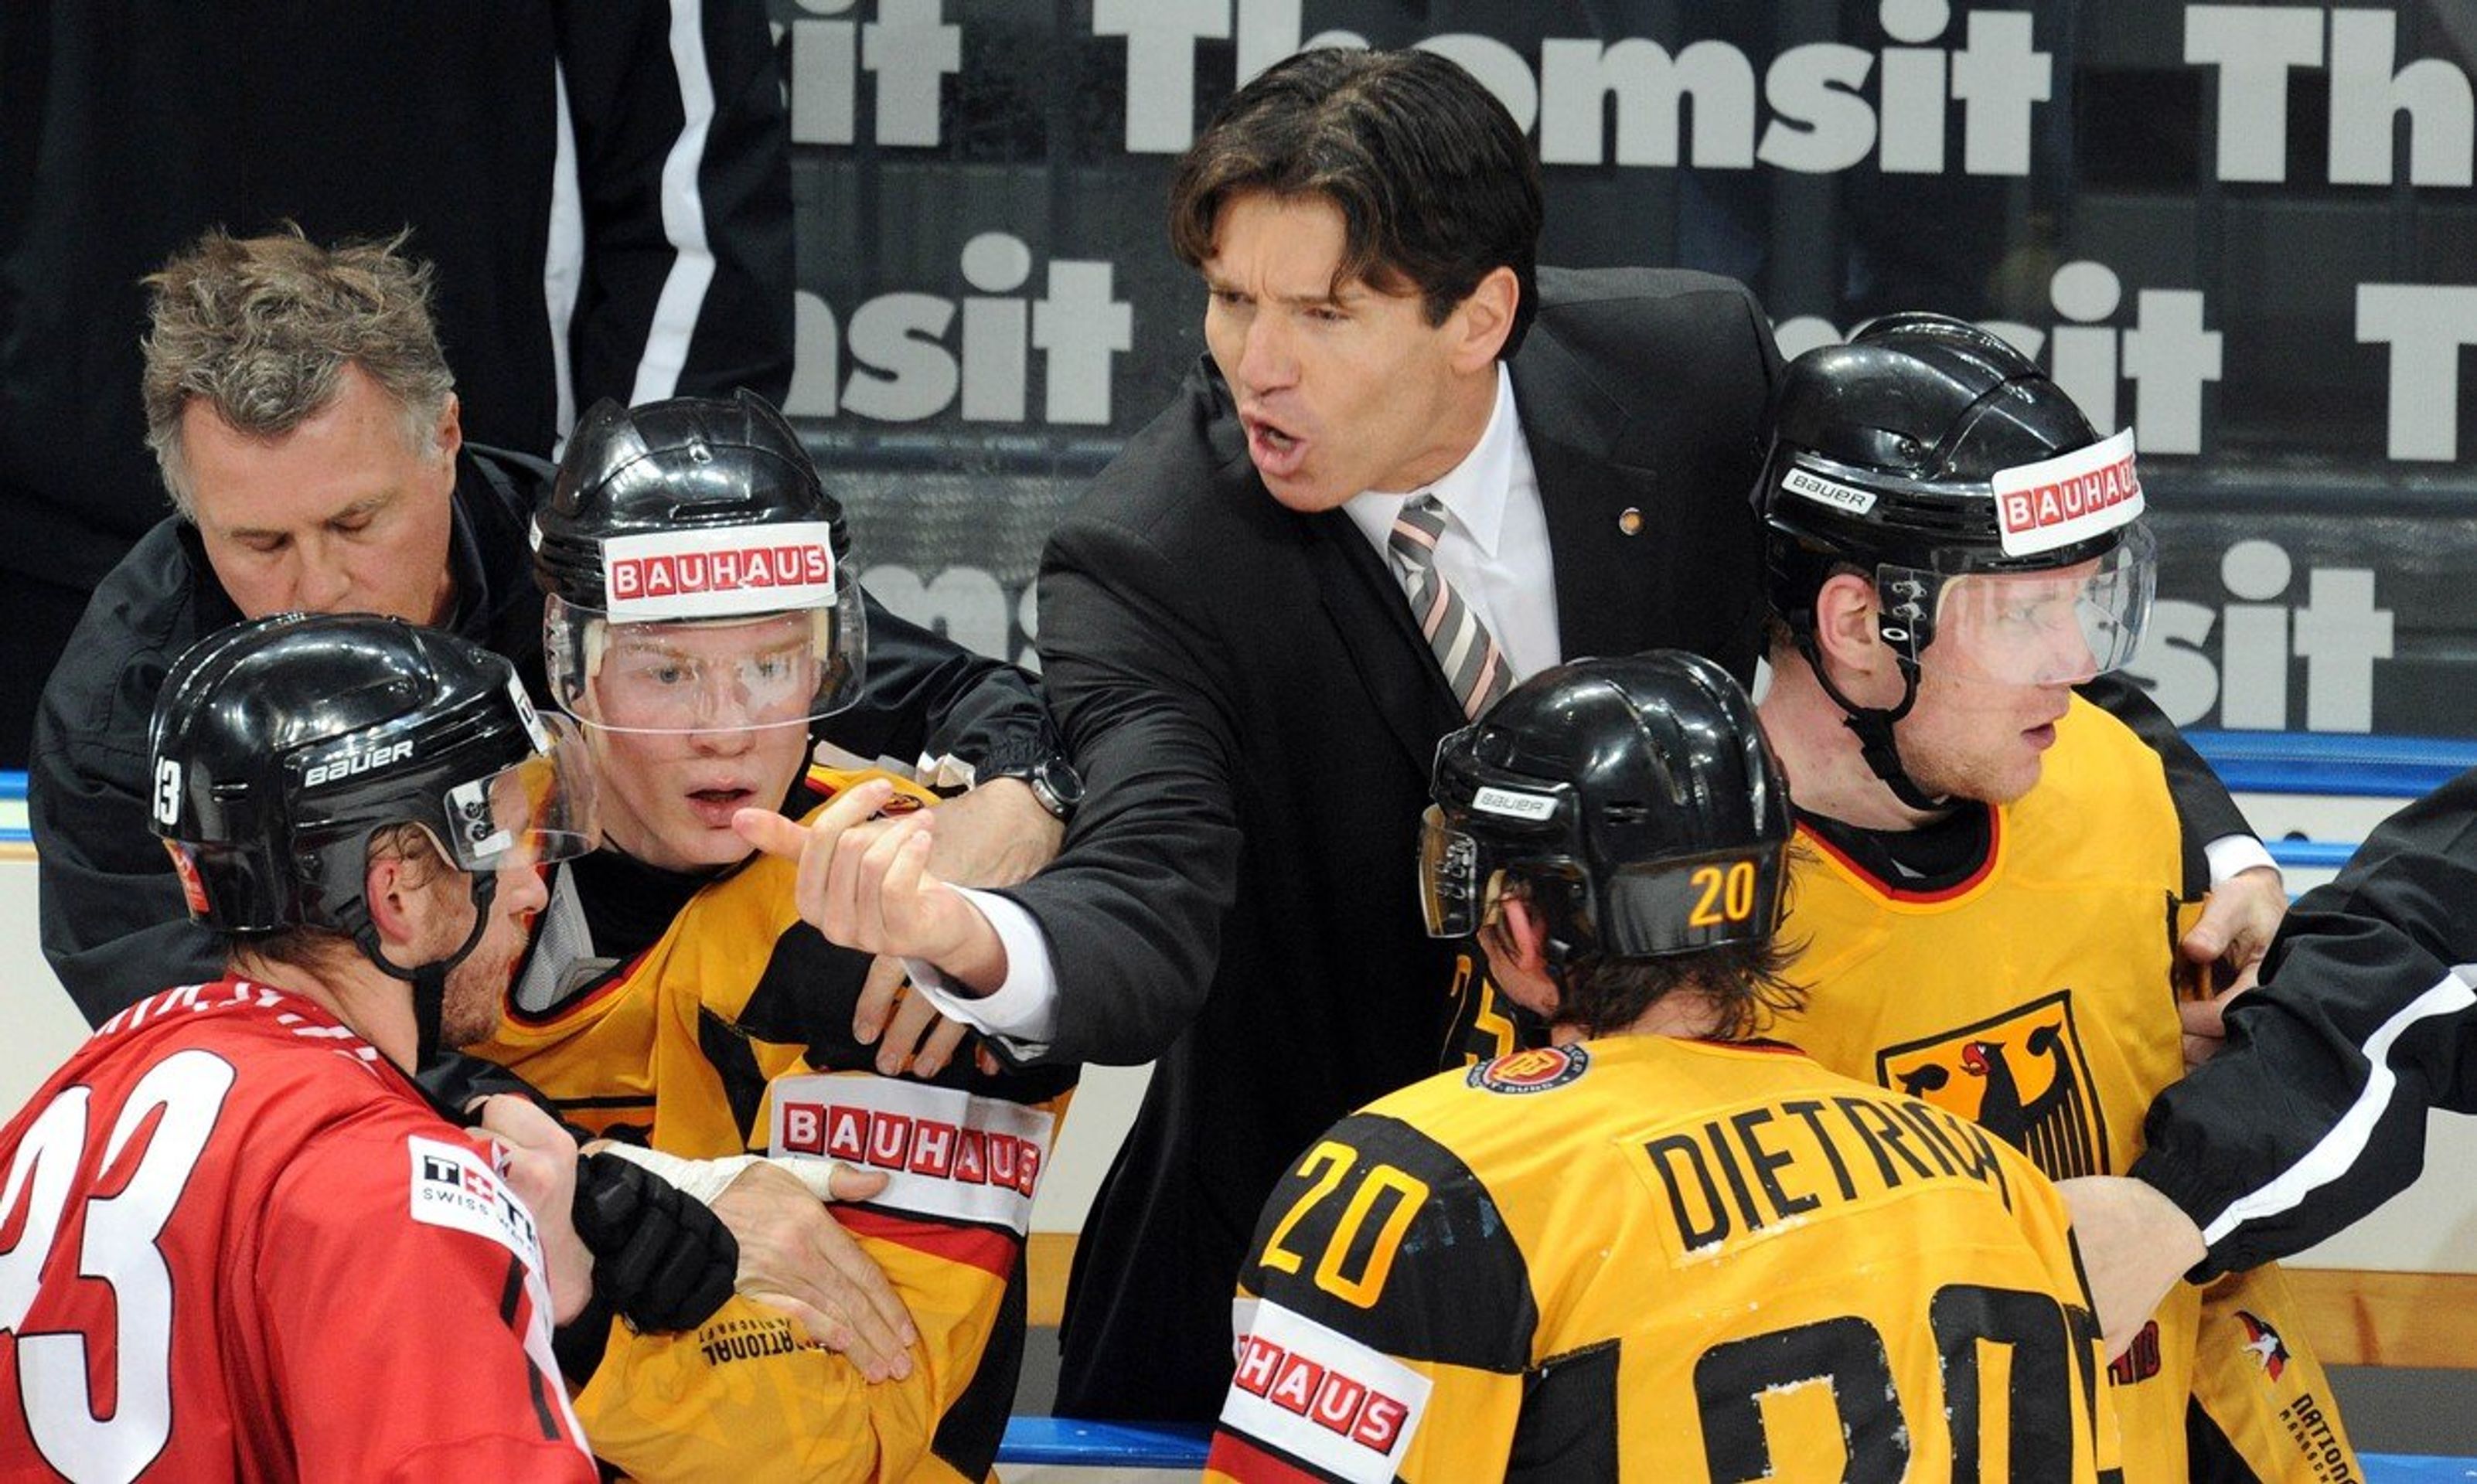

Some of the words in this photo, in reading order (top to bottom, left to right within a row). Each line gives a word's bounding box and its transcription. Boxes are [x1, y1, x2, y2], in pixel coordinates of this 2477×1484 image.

[768, 0, 962, 146] it
[2184, 5, 2475, 187] Th
[1790, 473, 1869, 509] BAUER
[2007, 458, 2138, 529] BAUHAU
[615, 546, 828, 595] BAUHAUS
[304, 740, 414, 788] BAUER
[1687, 861, 1756, 928] 20
[423, 1187, 489, 1216] SWISS
[1259, 1140, 1430, 1309] 20
[701, 1329, 809, 1367] ATIONAL
[1237, 1338, 1401, 1445] HAUS
